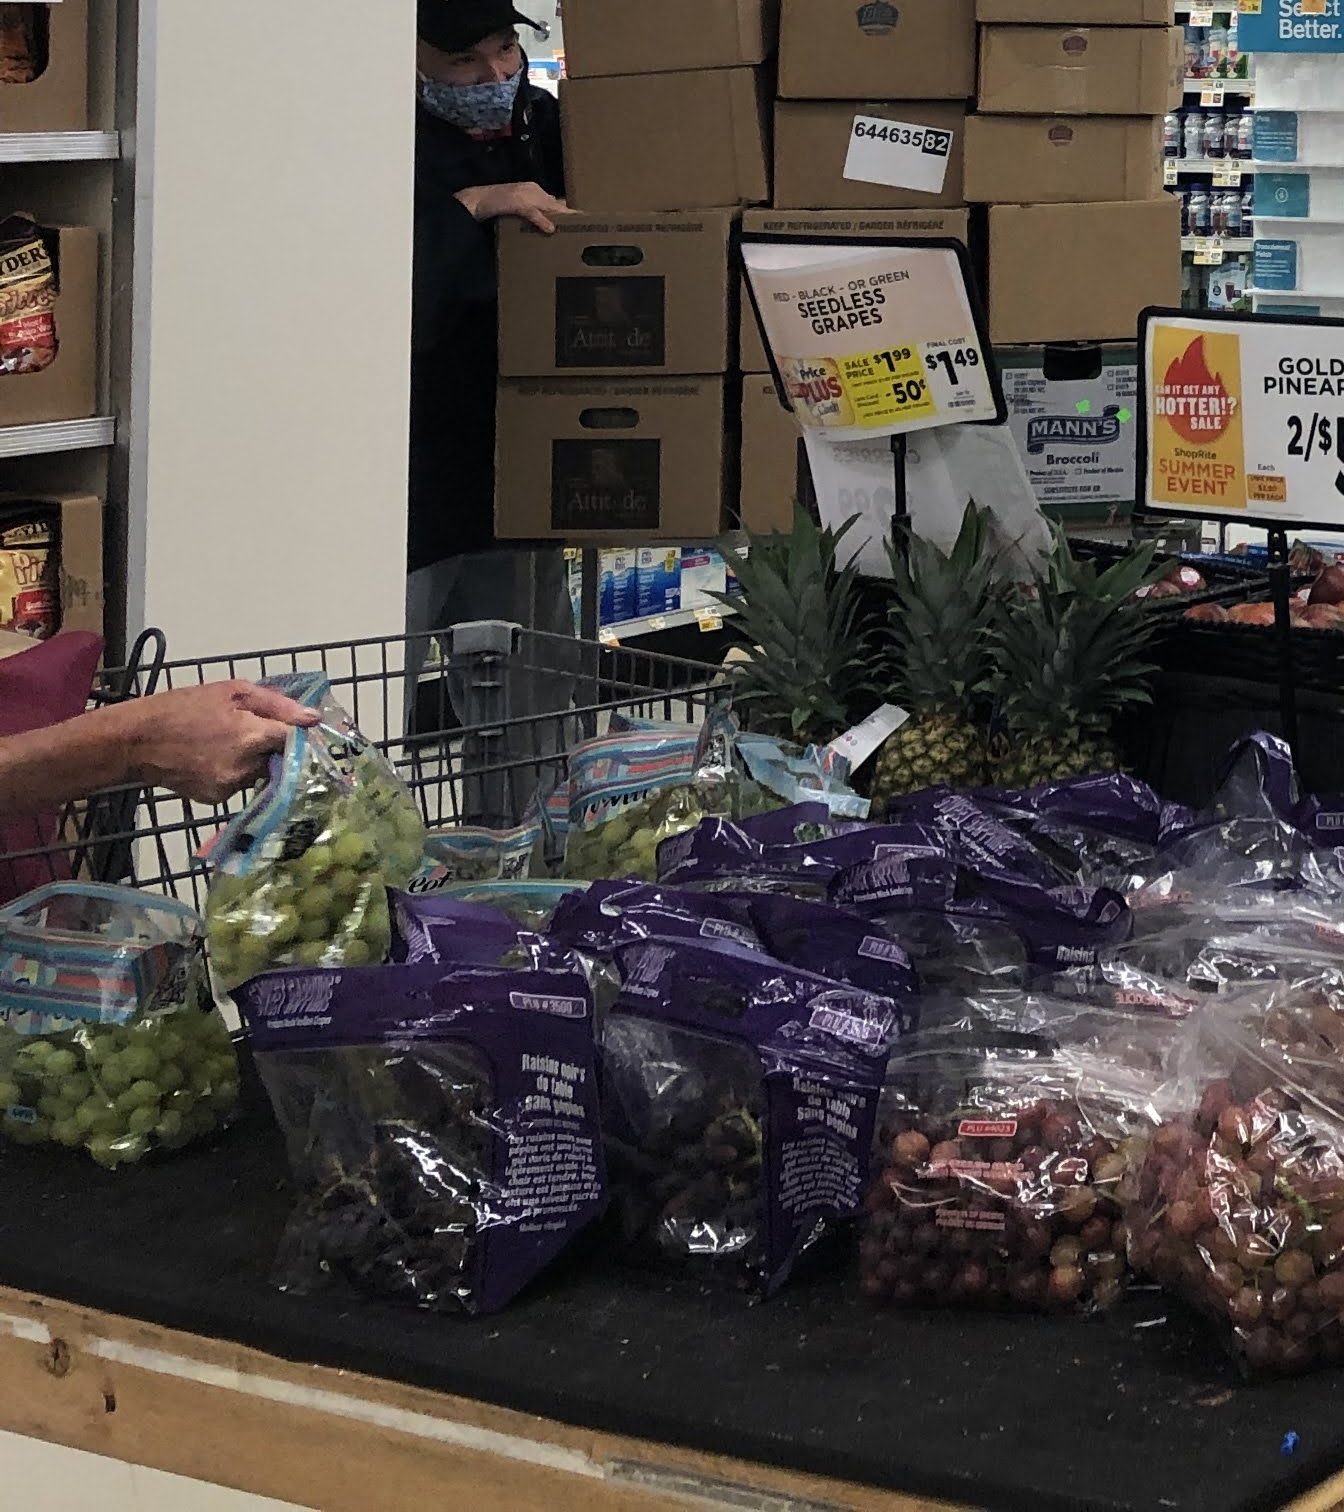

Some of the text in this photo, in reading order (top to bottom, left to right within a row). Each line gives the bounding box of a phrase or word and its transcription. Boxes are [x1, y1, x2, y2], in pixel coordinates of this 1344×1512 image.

[1279, 18, 1342, 39] Better.
[773, 270, 910, 303] RED BLACK OR GREEN
[798, 289, 886, 319] SEEDLESS
[811, 308, 883, 336] GRAPES
[926, 336, 967, 349] FINAL COST
[844, 357, 870, 370] SALE
[800, 366, 827, 380] Price
[846, 366, 875, 379] PRICE
[800, 376, 843, 404] PLUS
[1156, 385, 1220, 396] CAN IT GET ANY
[1155, 395, 1238, 416] HOTTER!?
[1032, 419, 1117, 437] MANN'S
[1190, 416, 1222, 431] SALE
[1046, 452, 1100, 465] Broccoli
[1174, 447, 1218, 461] ShopRite
[1159, 458, 1236, 481] SUMMER
[1257, 463, 1276, 472] Each
[1167, 476, 1228, 496] EVENT
